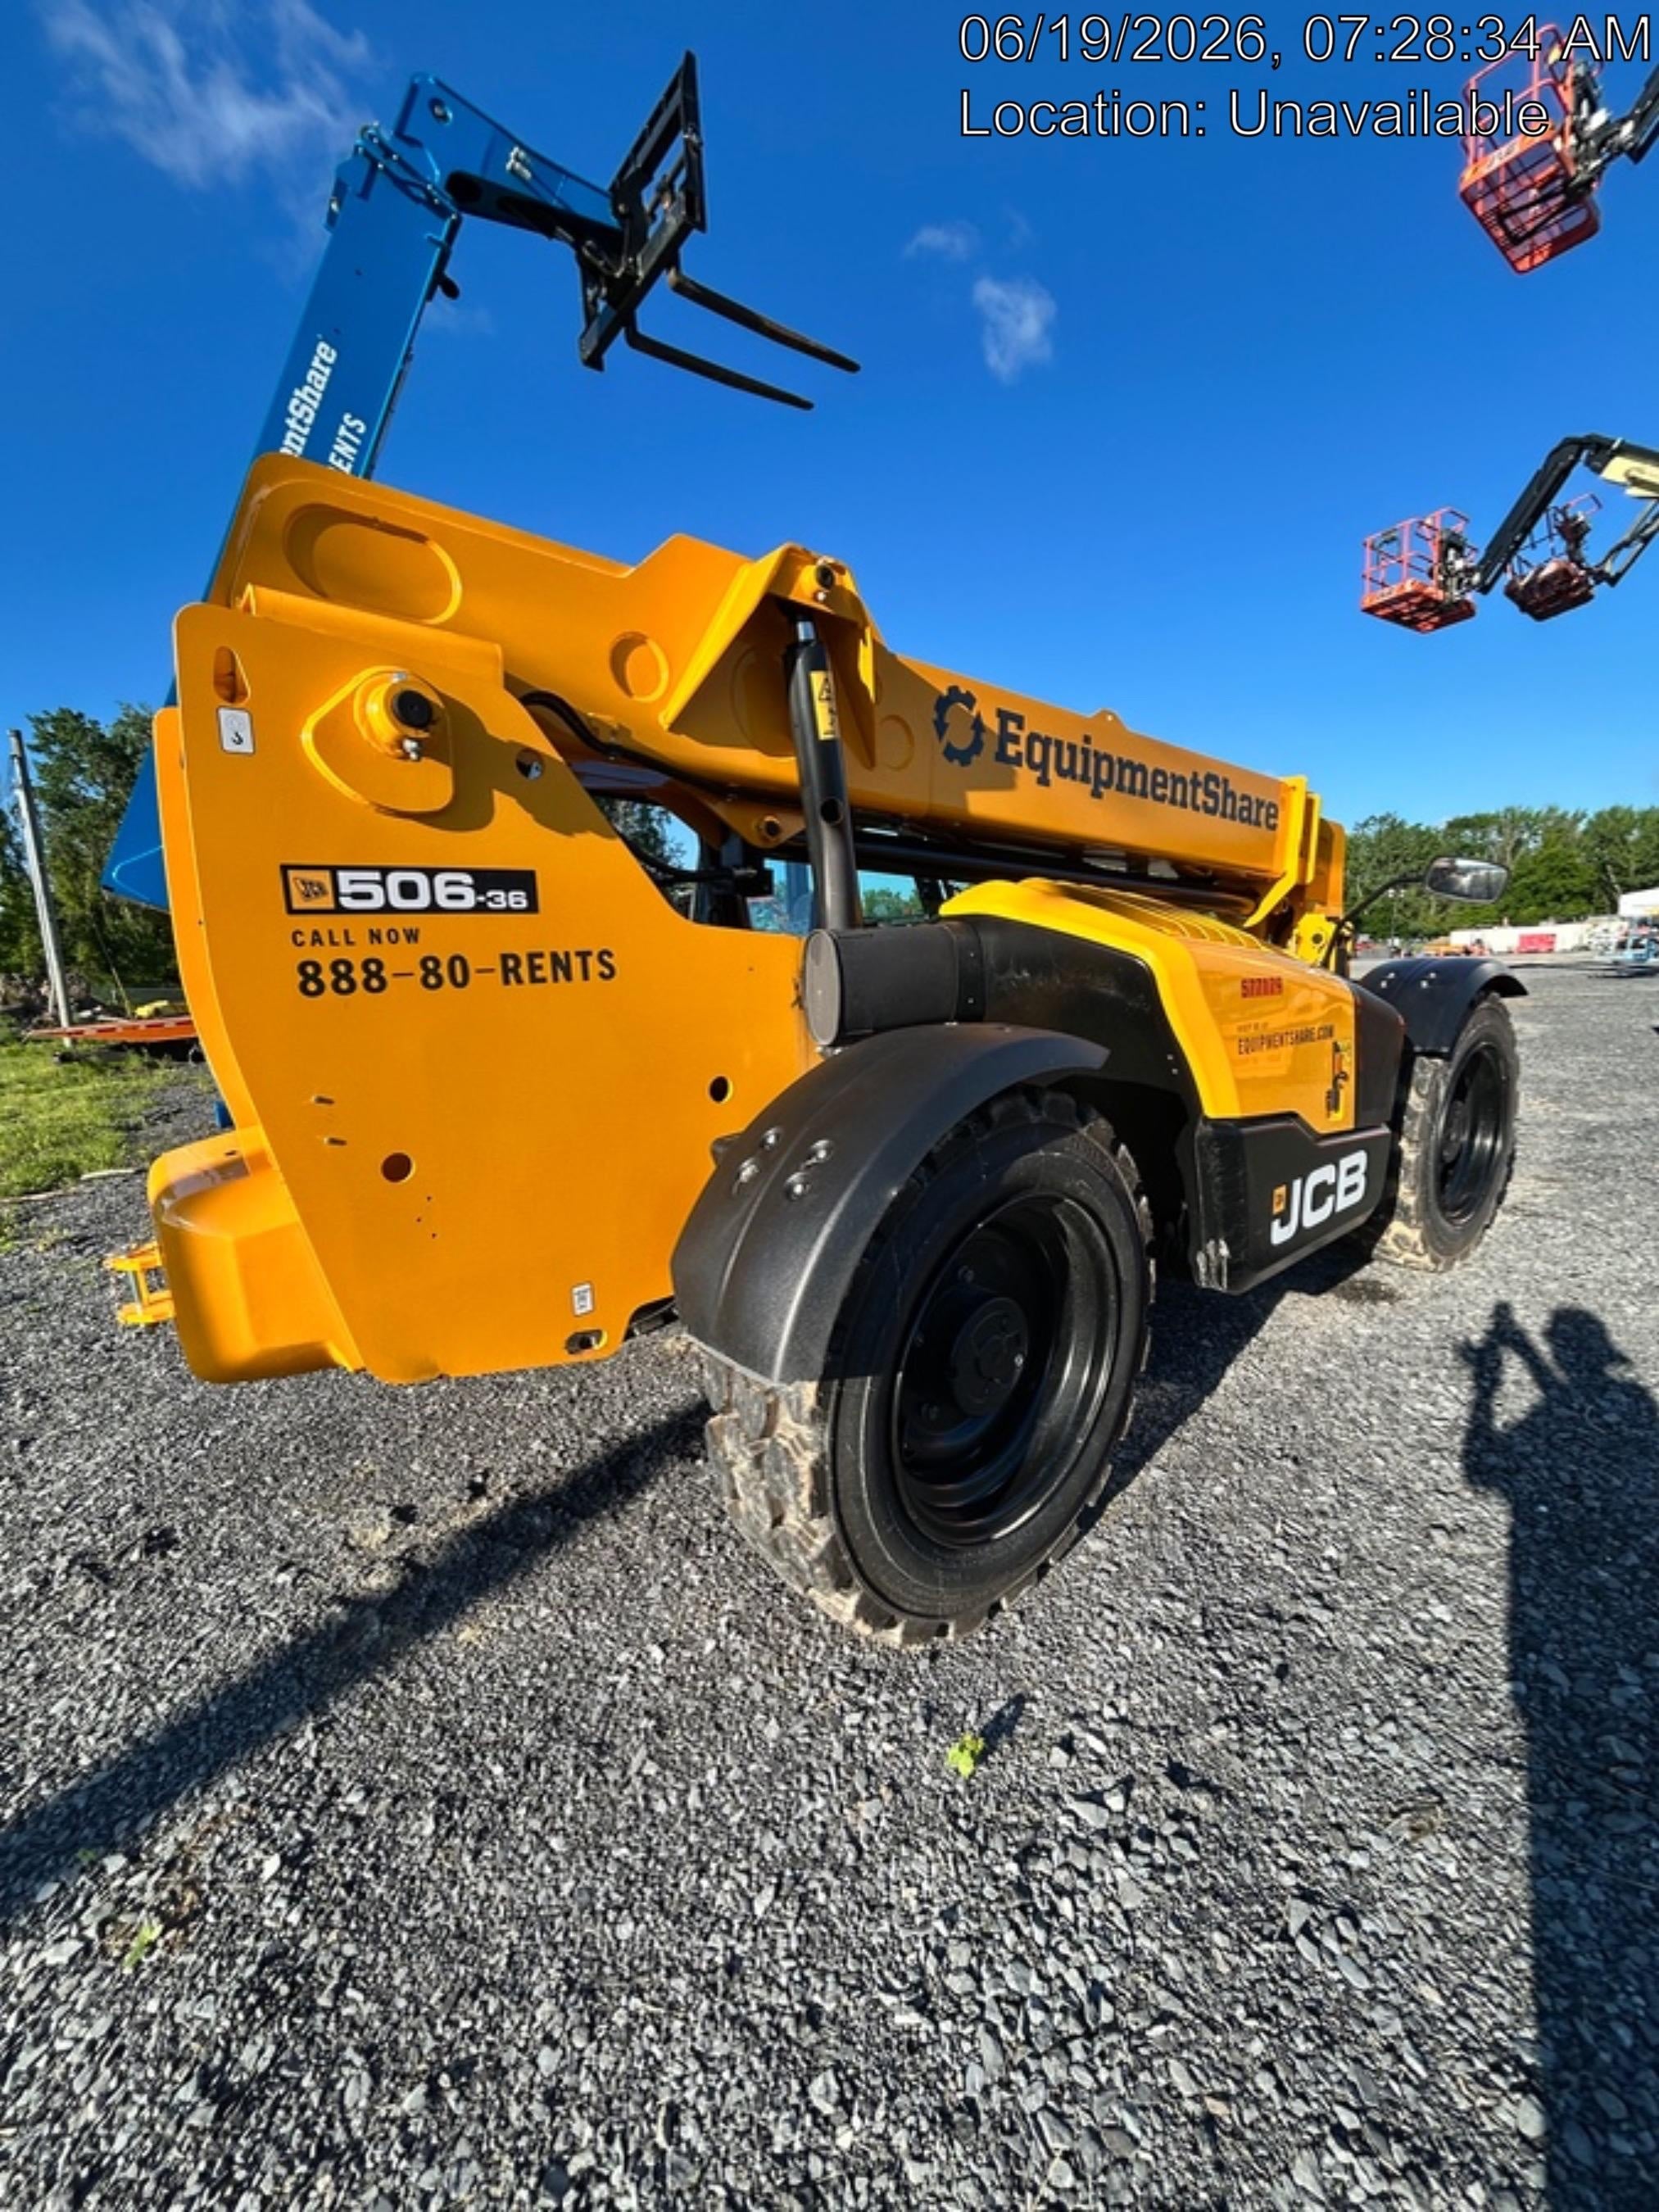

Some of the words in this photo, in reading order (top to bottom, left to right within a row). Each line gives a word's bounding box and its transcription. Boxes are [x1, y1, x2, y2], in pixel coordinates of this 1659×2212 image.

[329, 412, 366, 474] ENTS
[995, 707, 1279, 831] EquipmentShare
[337, 870, 527, 909] 506-36
[292, 930, 356, 946] CALL
[369, 928, 419, 945] NOW
[297, 949, 616, 998] 888-80-RENTS
[1271, 1149, 1367, 1244] JCB
